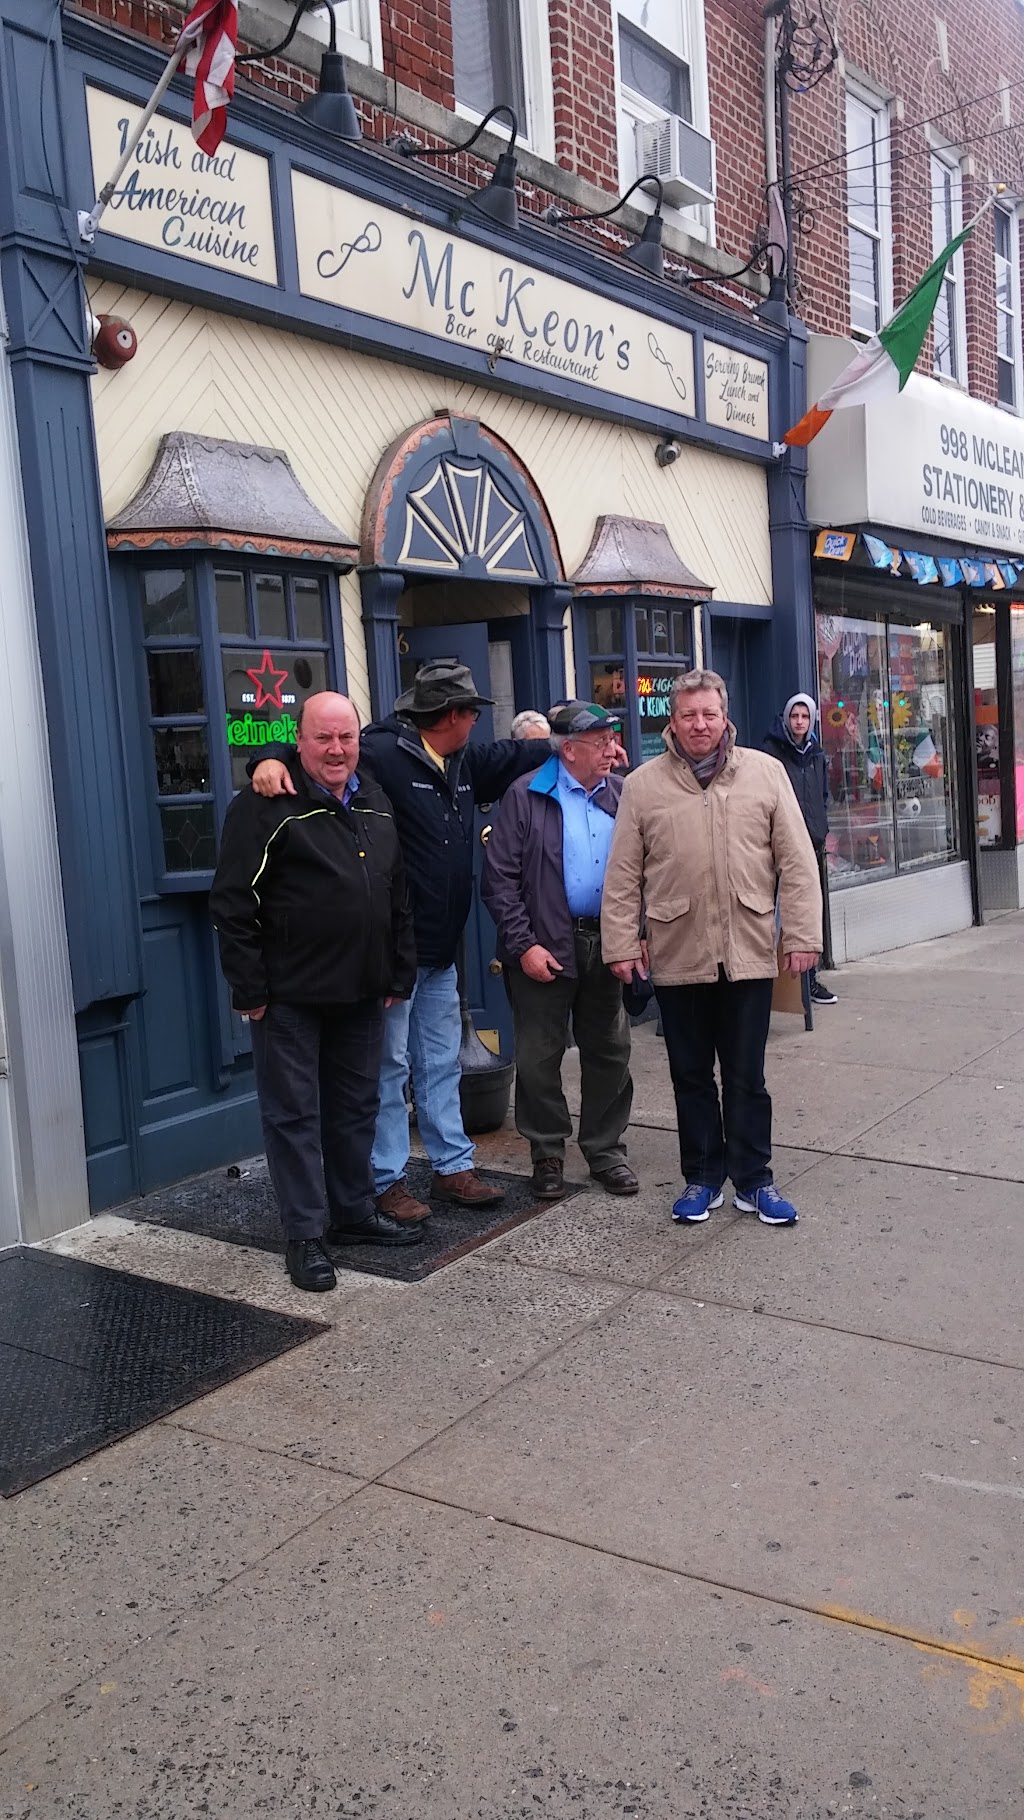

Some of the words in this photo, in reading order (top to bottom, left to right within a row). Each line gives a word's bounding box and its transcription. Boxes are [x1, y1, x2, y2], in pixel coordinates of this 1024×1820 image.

[117, 118, 181, 169] Irish
[191, 151, 236, 181] and
[108, 169, 246, 229] American
[162, 216, 259, 267] Cuisine
[496, 267, 631, 371] Keon's
[445, 313, 477, 339] Bar
[486, 332, 513, 354] and
[523, 341, 599, 381] Restaurant
[706, 352, 740, 383] Serving
[742, 362, 765, 391] Brunch
[719, 379, 746, 402] Lunch
[748, 393, 760, 402] and
[726, 402, 757, 427] Dinner
[940, 424, 969, 462] 998
[923, 463, 1013, 518] STATIONERY
[922, 505, 936, 525] COLD
[938, 509, 967, 532] BEVERAGES
[974, 518, 991, 537] CANDY
[242, 693, 257, 703] EST.
[226, 713, 297, 745] einek
